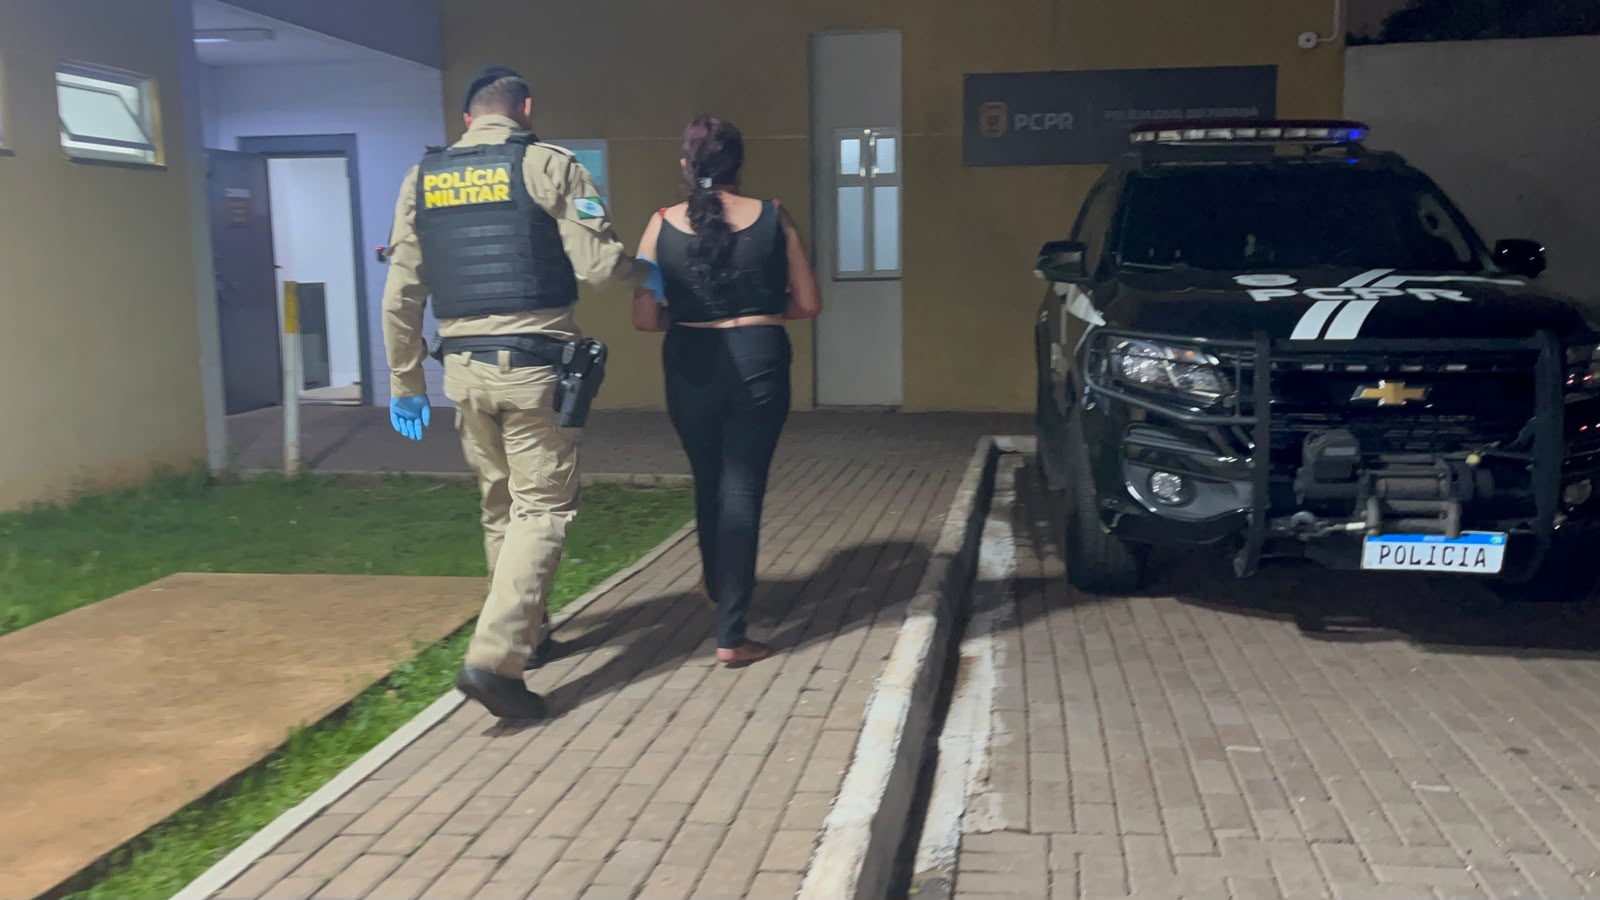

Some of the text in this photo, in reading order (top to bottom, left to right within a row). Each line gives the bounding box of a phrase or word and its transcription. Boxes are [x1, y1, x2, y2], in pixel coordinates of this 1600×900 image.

[1014, 112, 1073, 131] PCPR
[424, 167, 510, 190] POLÍCIA
[425, 184, 510, 208] MILITAR
[1247, 287, 1472, 301] PCPR
[1379, 545, 1486, 568] POLICIA
